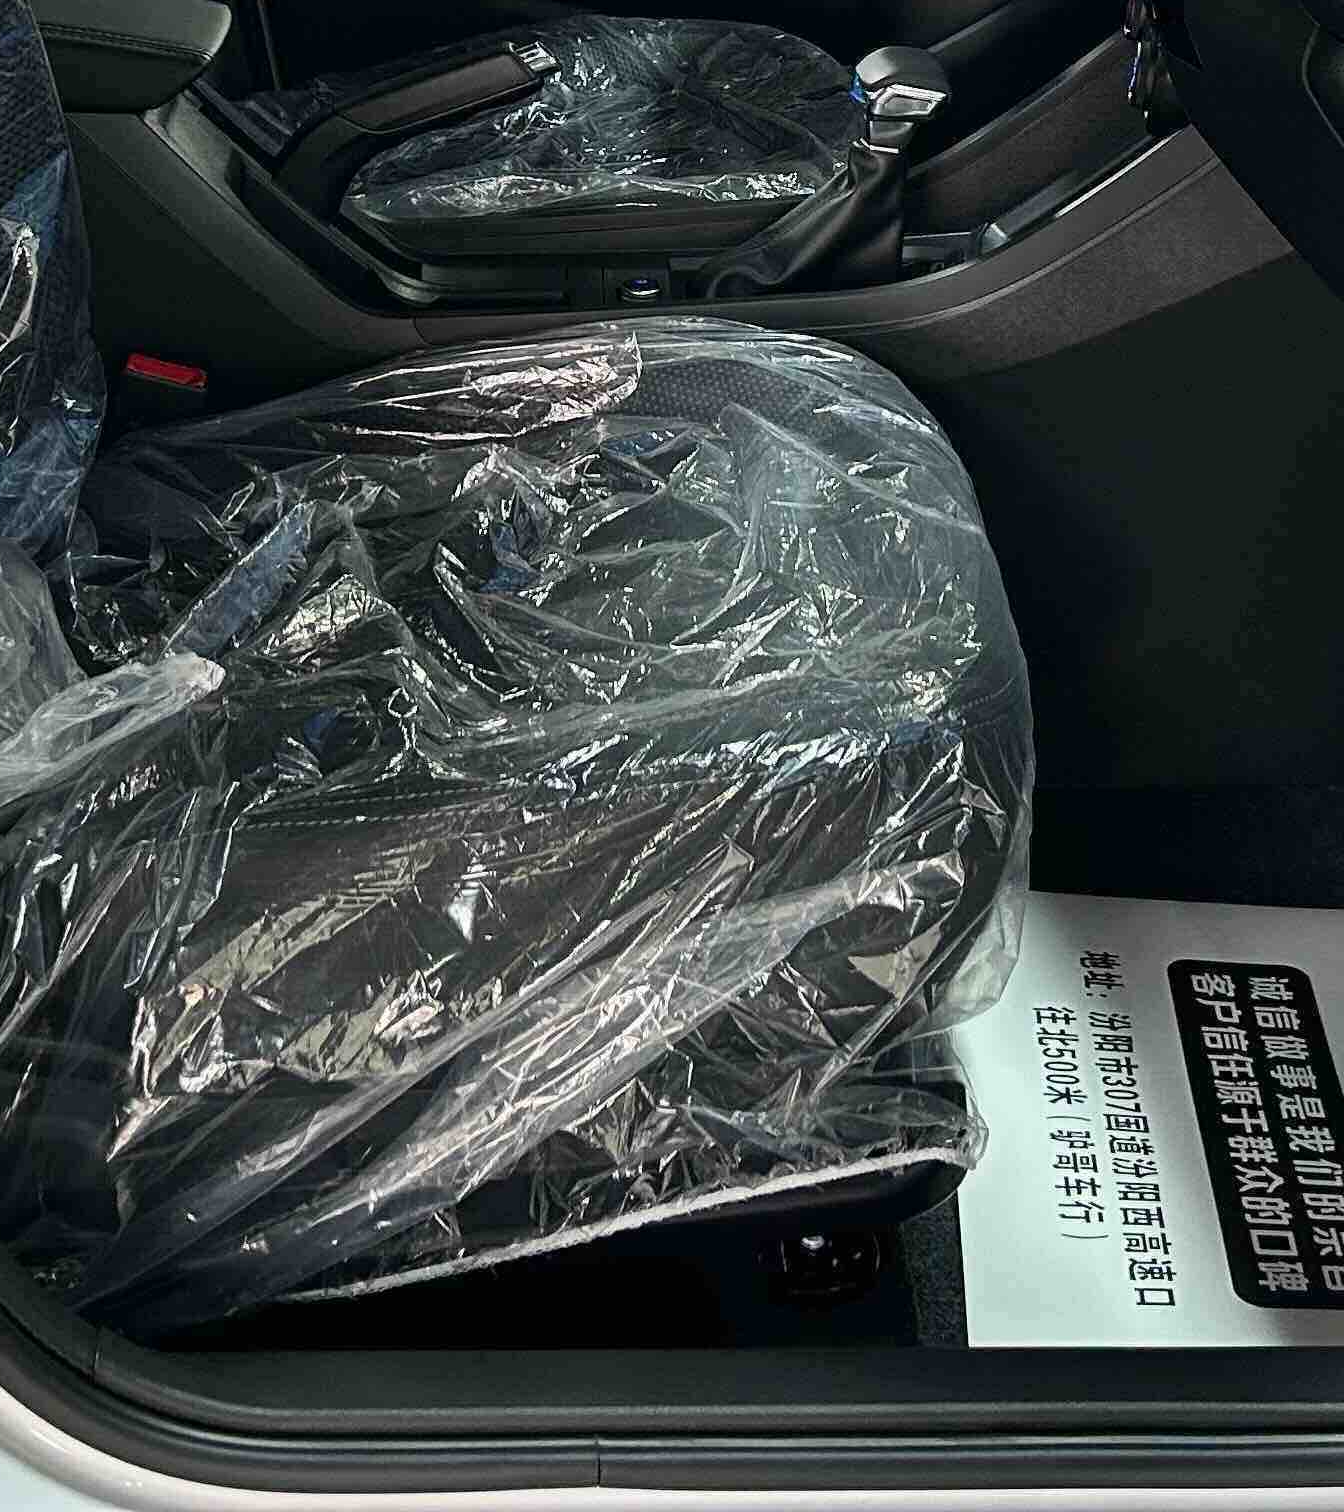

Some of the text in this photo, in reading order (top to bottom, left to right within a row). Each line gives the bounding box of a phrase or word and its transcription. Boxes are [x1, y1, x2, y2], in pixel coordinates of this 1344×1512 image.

[1190, 972, 1310, 1292] 客户信任源于群众的口碑
